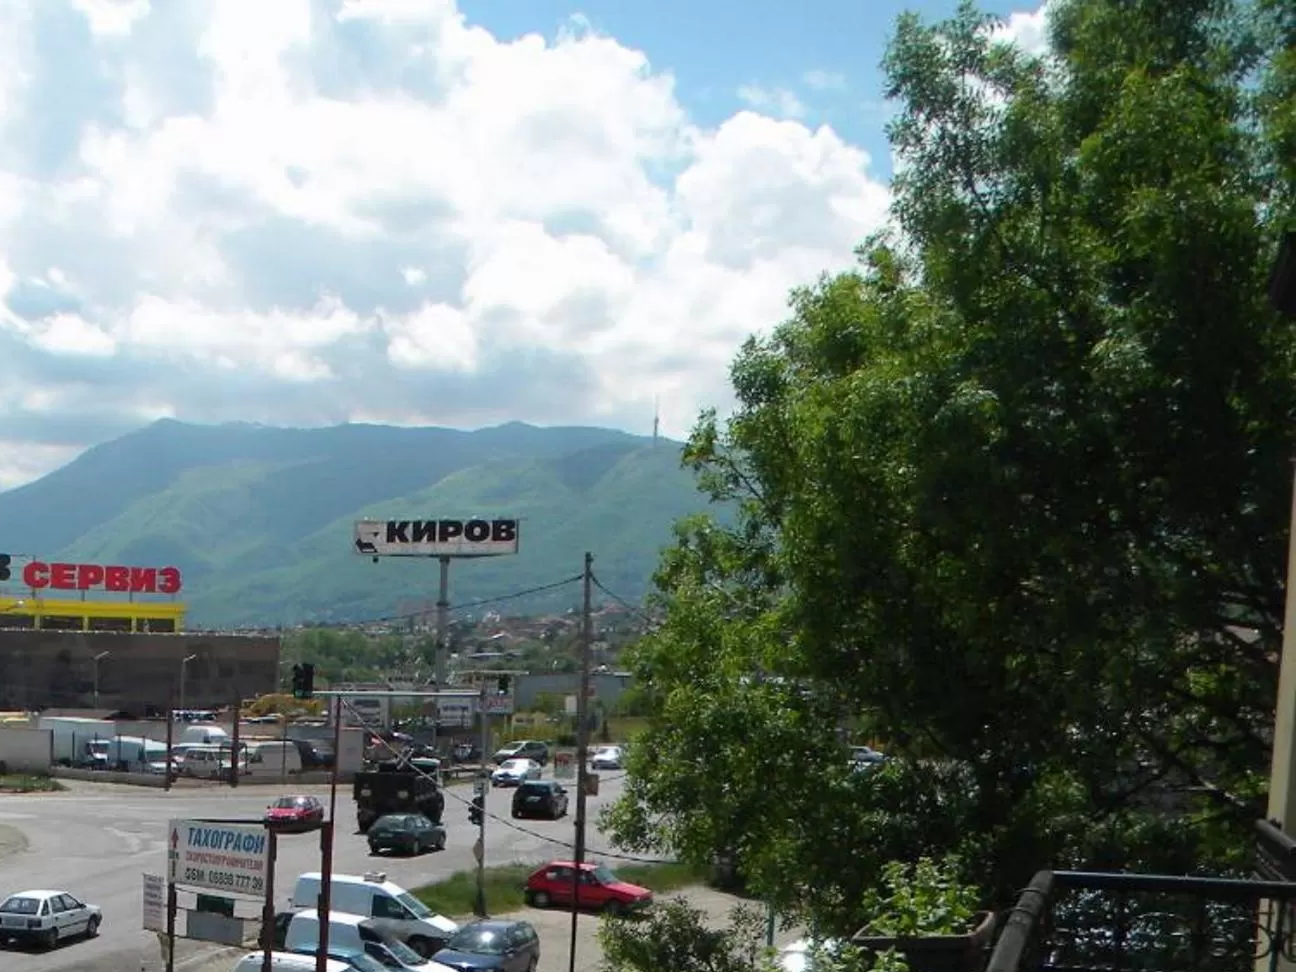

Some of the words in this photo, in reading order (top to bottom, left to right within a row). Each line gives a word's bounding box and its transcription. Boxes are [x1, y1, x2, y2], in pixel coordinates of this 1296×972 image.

[387, 519, 516, 543] КИРОВ
[22, 561, 182, 594] СЕРВИЗ
[187, 827, 266, 854] ТАХОГРАФИ
